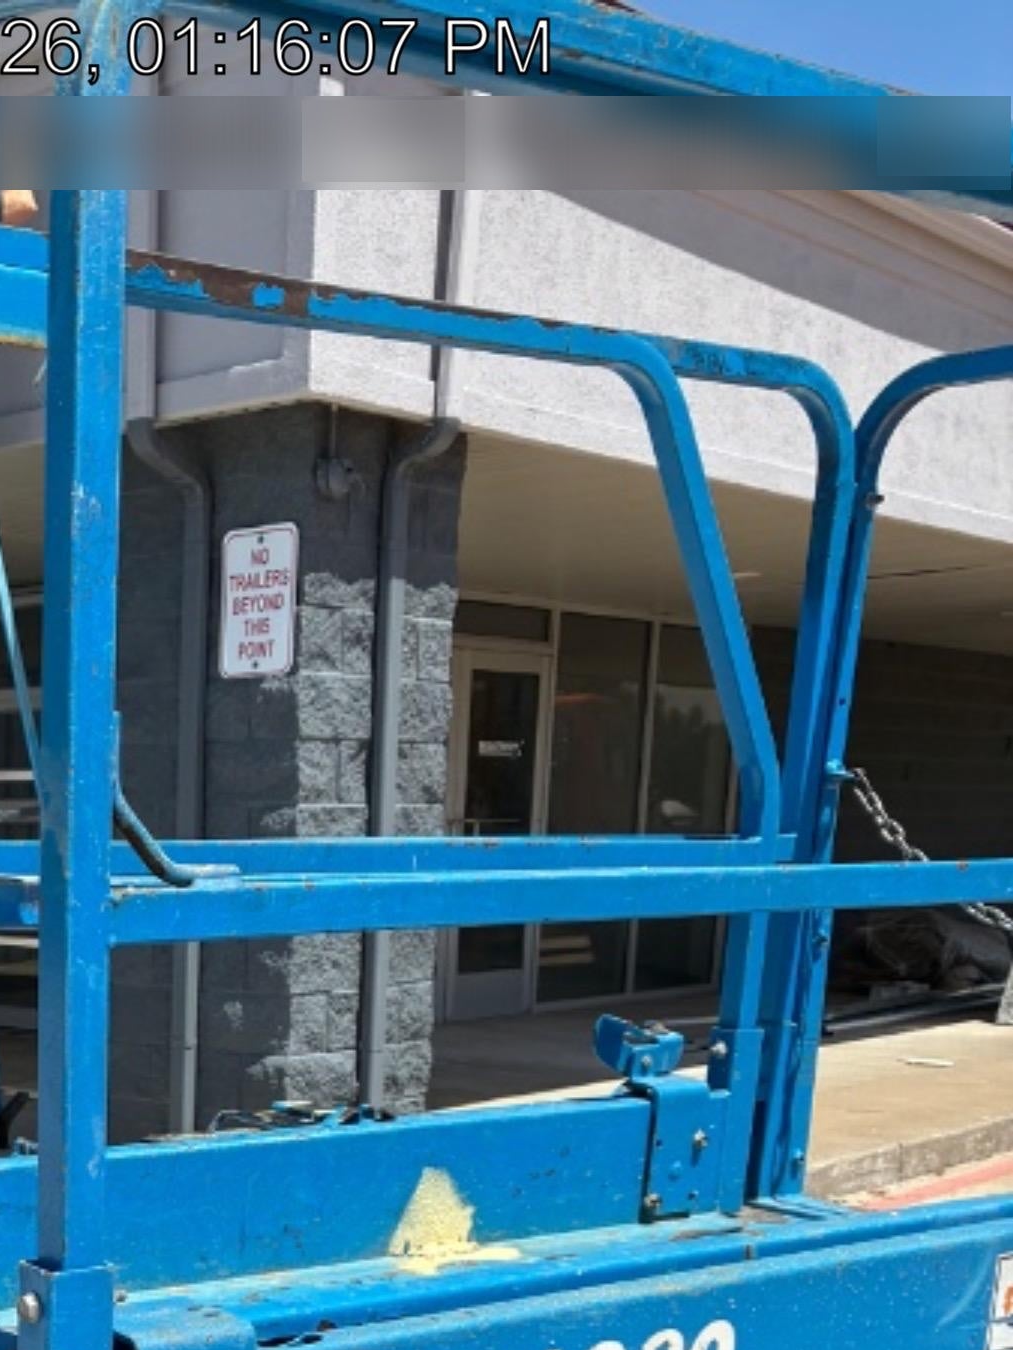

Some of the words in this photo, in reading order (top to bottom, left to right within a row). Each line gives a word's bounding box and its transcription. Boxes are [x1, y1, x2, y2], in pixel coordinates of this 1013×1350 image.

[250, 547, 270, 566] NO
[229, 567, 290, 592] TRAILERS
[232, 593, 284, 616] BEYOND
[242, 617, 271, 636] THIS
[238, 639, 275, 661] POINT
